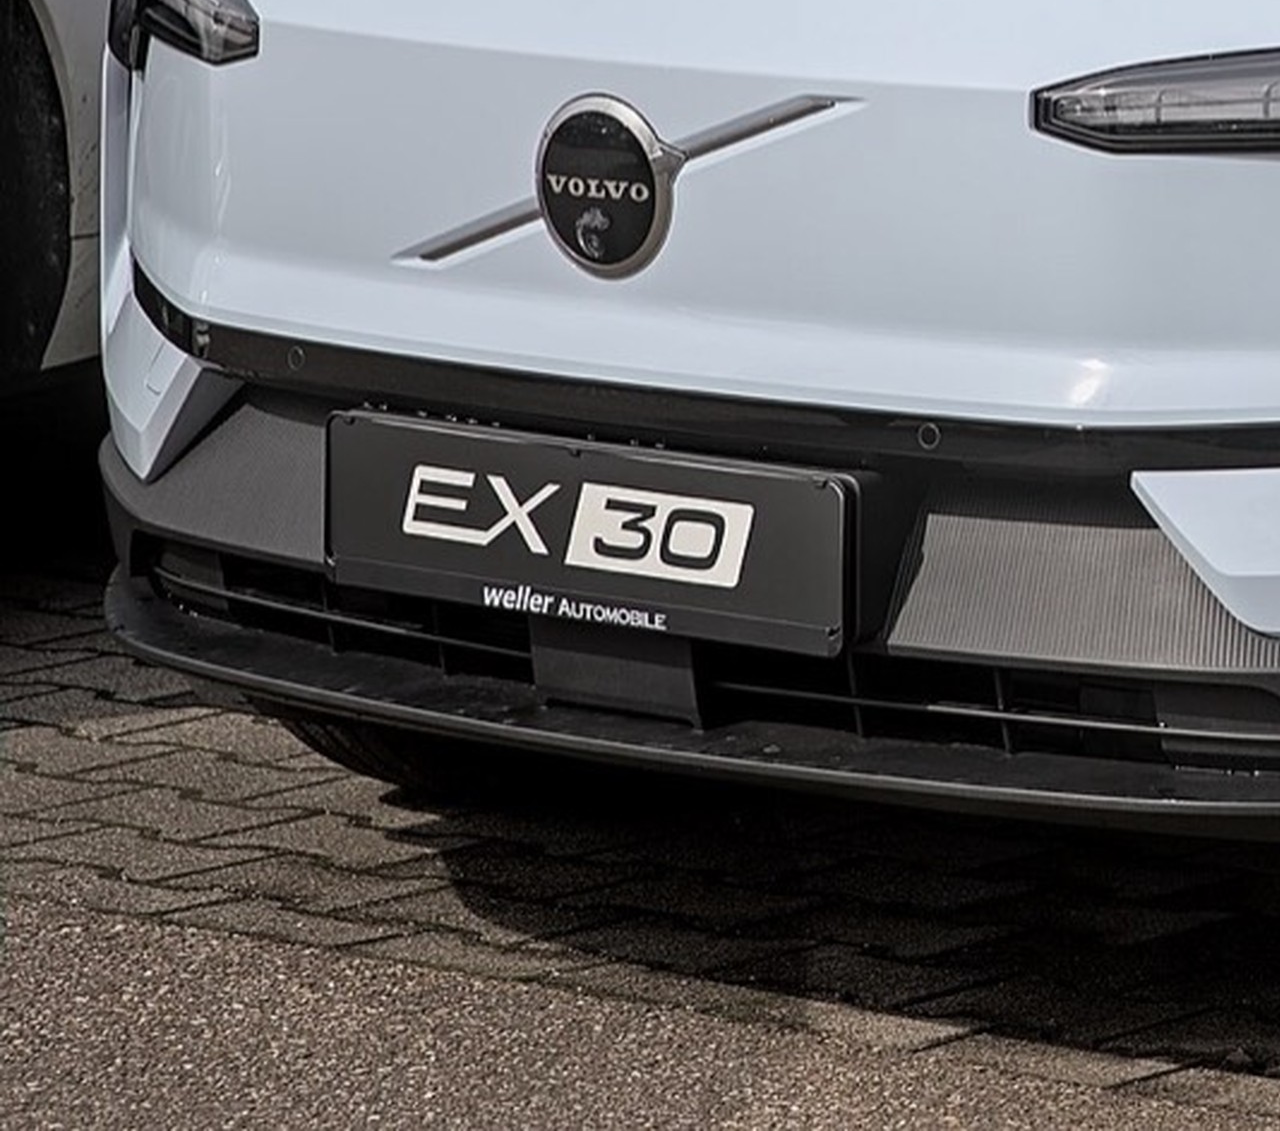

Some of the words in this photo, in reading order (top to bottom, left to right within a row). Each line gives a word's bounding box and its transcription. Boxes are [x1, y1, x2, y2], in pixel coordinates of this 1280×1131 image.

[546, 173, 650, 203] VOLVO
[402, 464, 562, 556] EX
[593, 497, 727, 571] 30
[482, 585, 554, 615] weller
[557, 596, 667, 631] AUTOMOBILE
